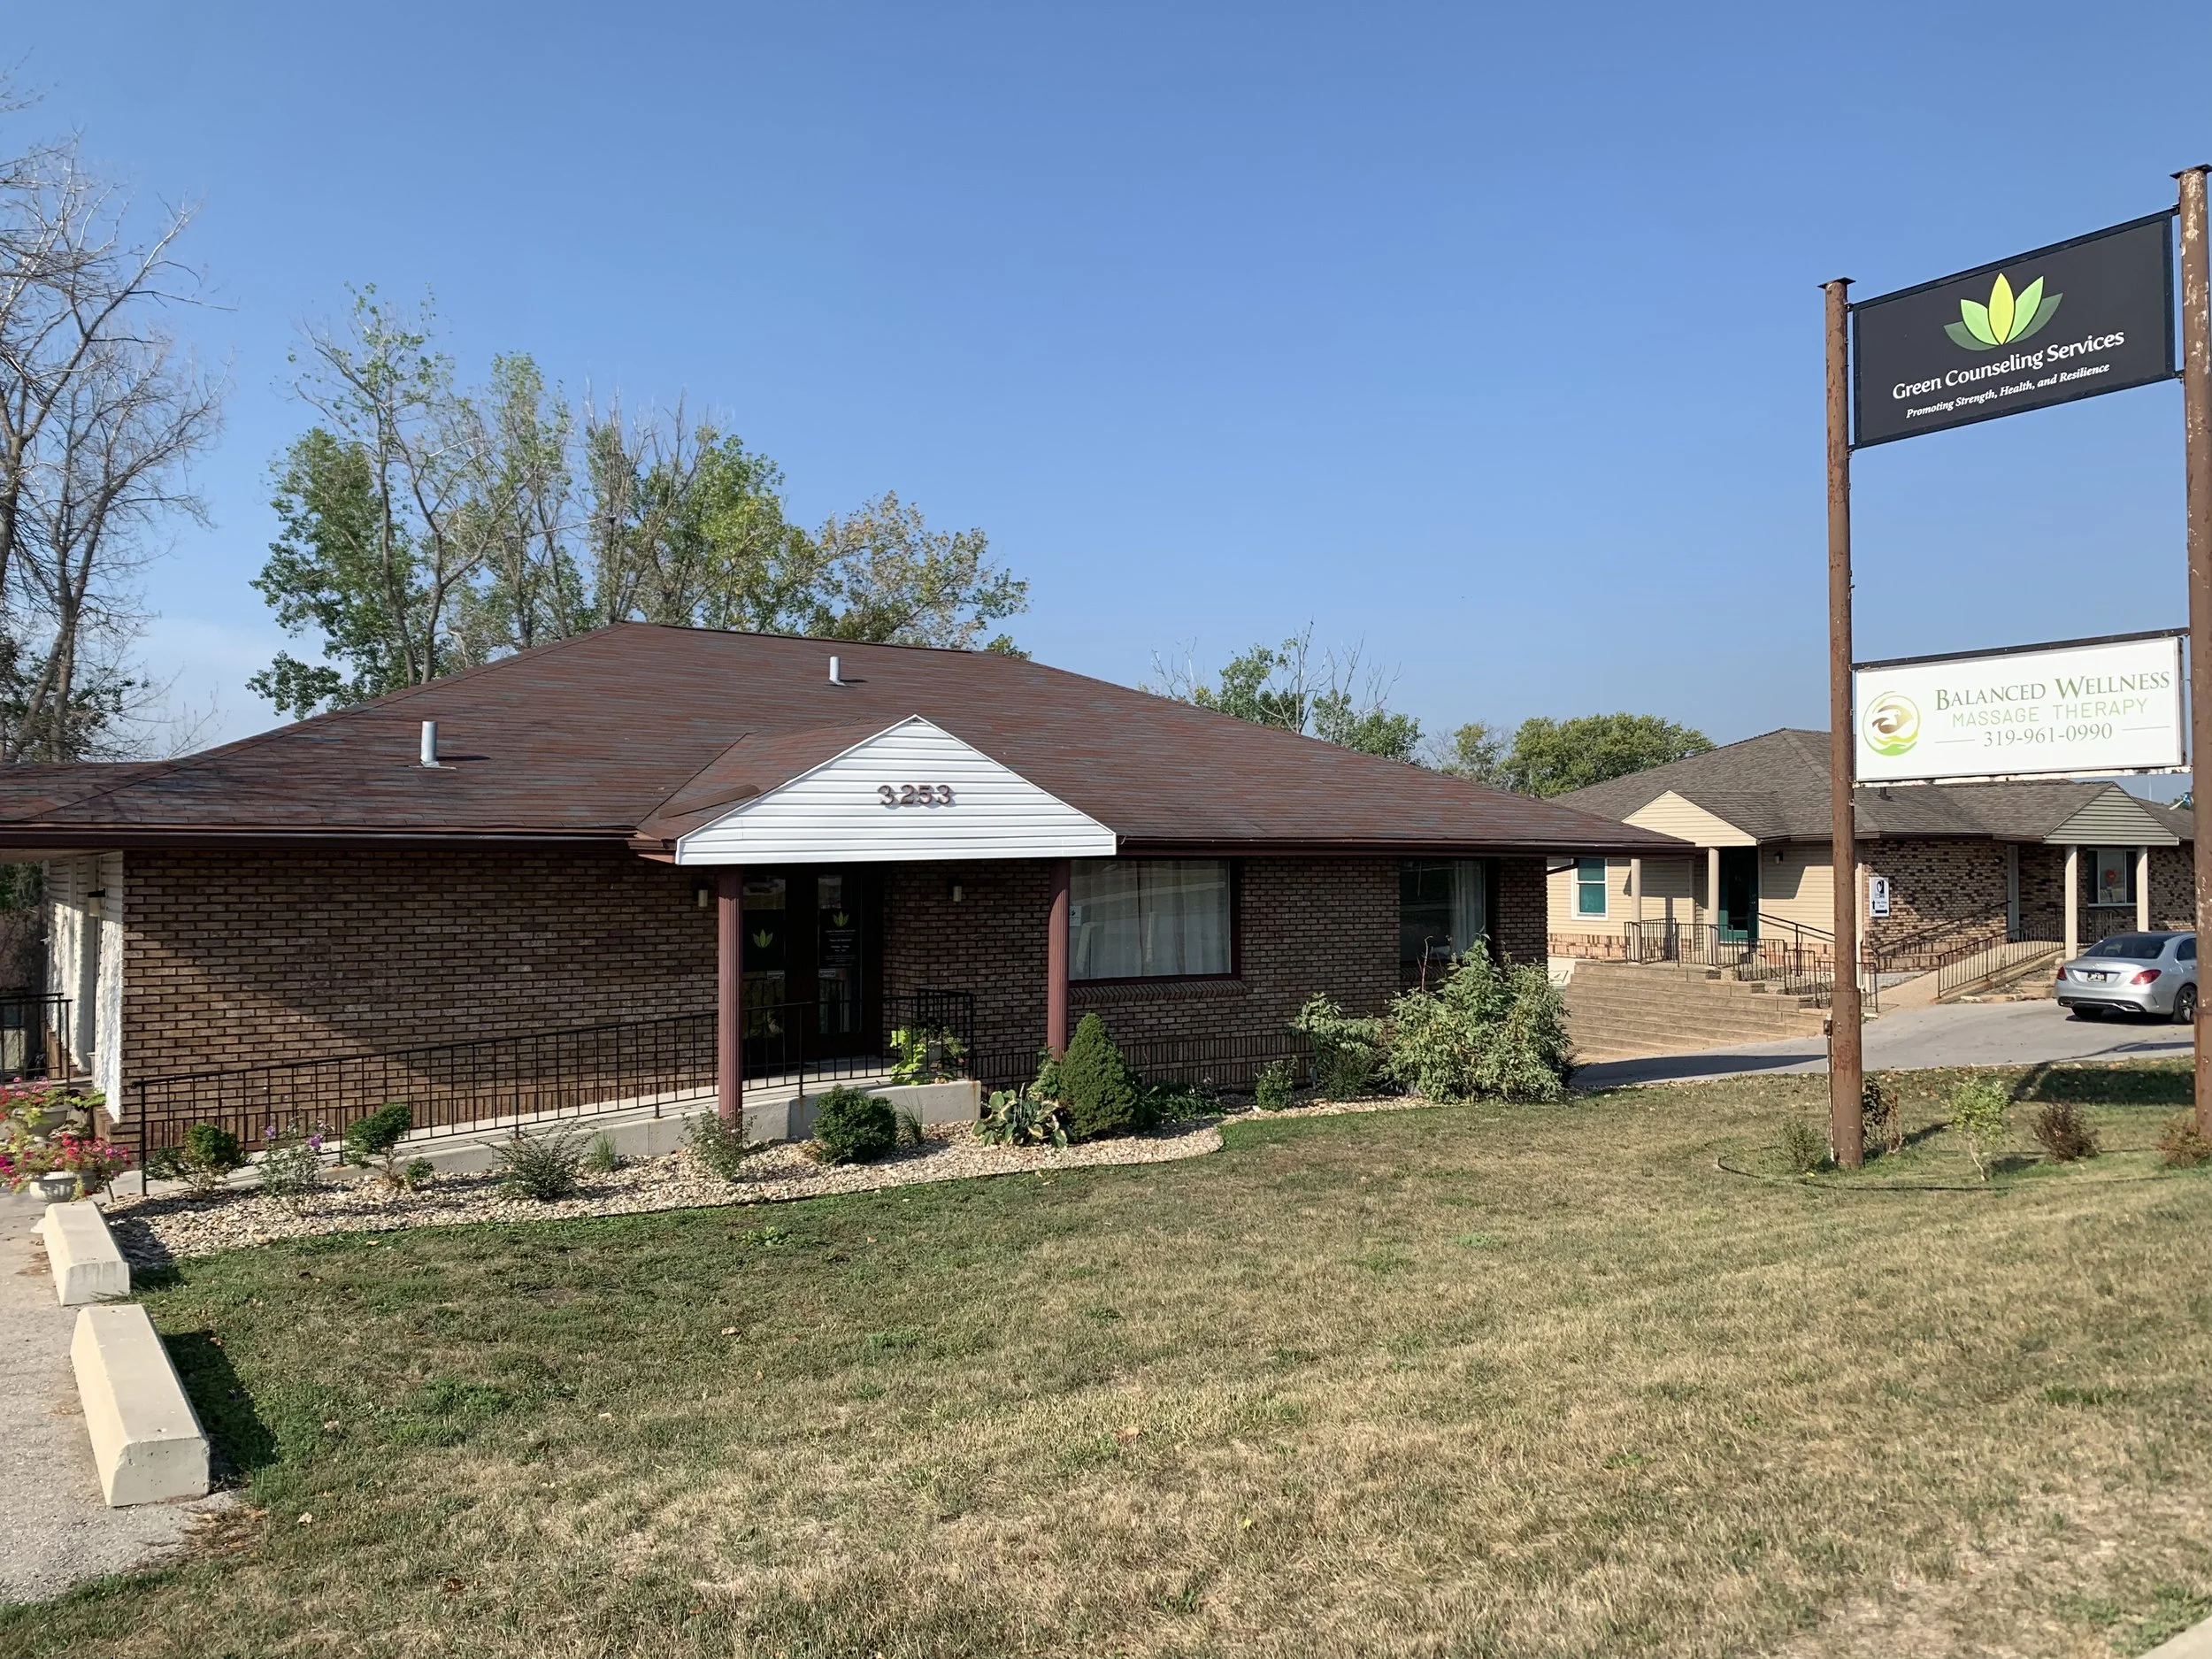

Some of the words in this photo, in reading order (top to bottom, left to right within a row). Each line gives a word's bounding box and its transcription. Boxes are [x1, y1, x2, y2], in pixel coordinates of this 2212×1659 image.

[1892, 377, 1942, 400] Green
[1945, 349, 2044, 387] Counseling
[2047, 331, 2125, 362] Services
[1906, 400, 1955, 419] Promoting
[1955, 388, 1998, 407] Strength,
[1999, 380, 2036, 397] Health,
[2037, 373, 2058, 388] and
[2059, 364, 2110, 383] Resilience
[1935, 683, 2047, 711] BALANCED
[2055, 671, 2170, 700] WELLNESS
[1952, 706, 2039, 728] MASSAGE
[2053, 697, 2148, 720] THERAPY
[1983, 722, 2113, 748] 319-961-0990
[877, 784, 953, 806] 3253
